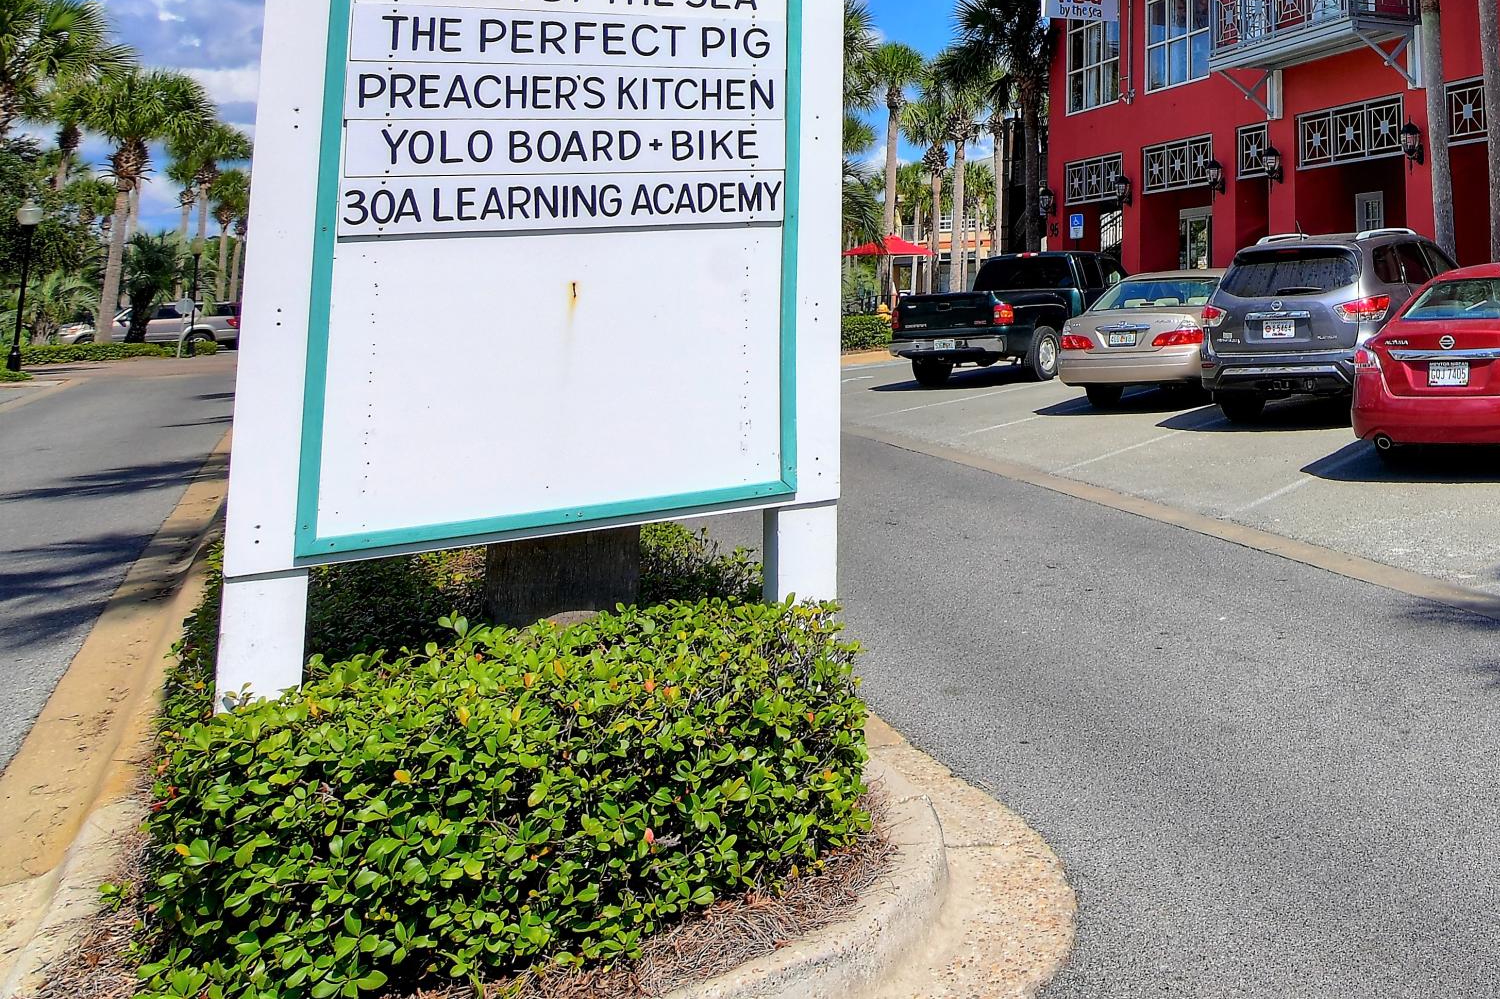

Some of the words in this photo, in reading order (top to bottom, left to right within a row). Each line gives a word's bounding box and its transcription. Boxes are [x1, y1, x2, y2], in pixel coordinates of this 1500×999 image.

[1059, 4, 1070, 17] by
[1072, 4, 1088, 17] the
[381, 15, 462, 53] THE
[479, 18, 687, 58] PERFECT
[701, 26, 771, 59] PIG
[358, 73, 606, 111] PREACHER'S
[617, 76, 775, 111] KITCHEN
[381, 129, 494, 165] YOLO
[508, 129, 642, 163] BOARD
[671, 129, 760, 162] BIKE
[343, 187, 422, 226] 30A
[433, 184, 623, 222] LEARNING
[630, 180, 783, 216] ACADEMY
[1447, 368, 1466, 380] 7405
